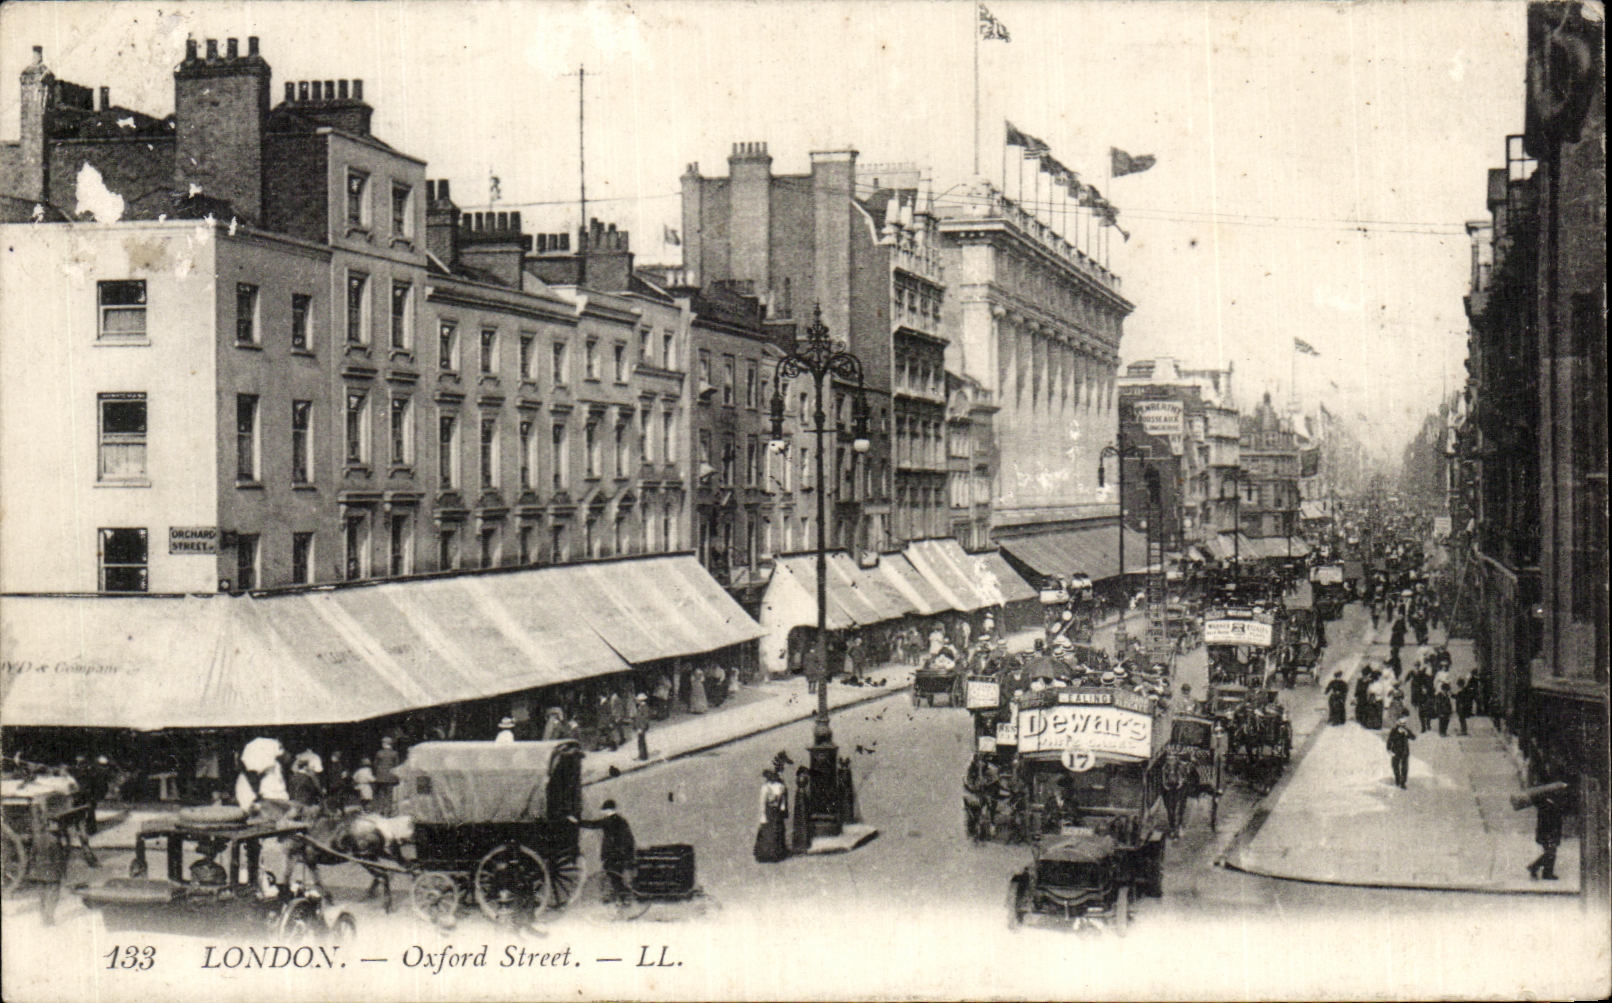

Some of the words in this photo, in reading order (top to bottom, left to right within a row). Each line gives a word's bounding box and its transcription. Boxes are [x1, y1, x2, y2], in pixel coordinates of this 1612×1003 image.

[171, 530, 216, 539] ORCHARD
[1067, 693, 1110, 704] EALING
[1023, 713, 1147, 741] Dewar's
[1067, 753, 1090, 769] 17
